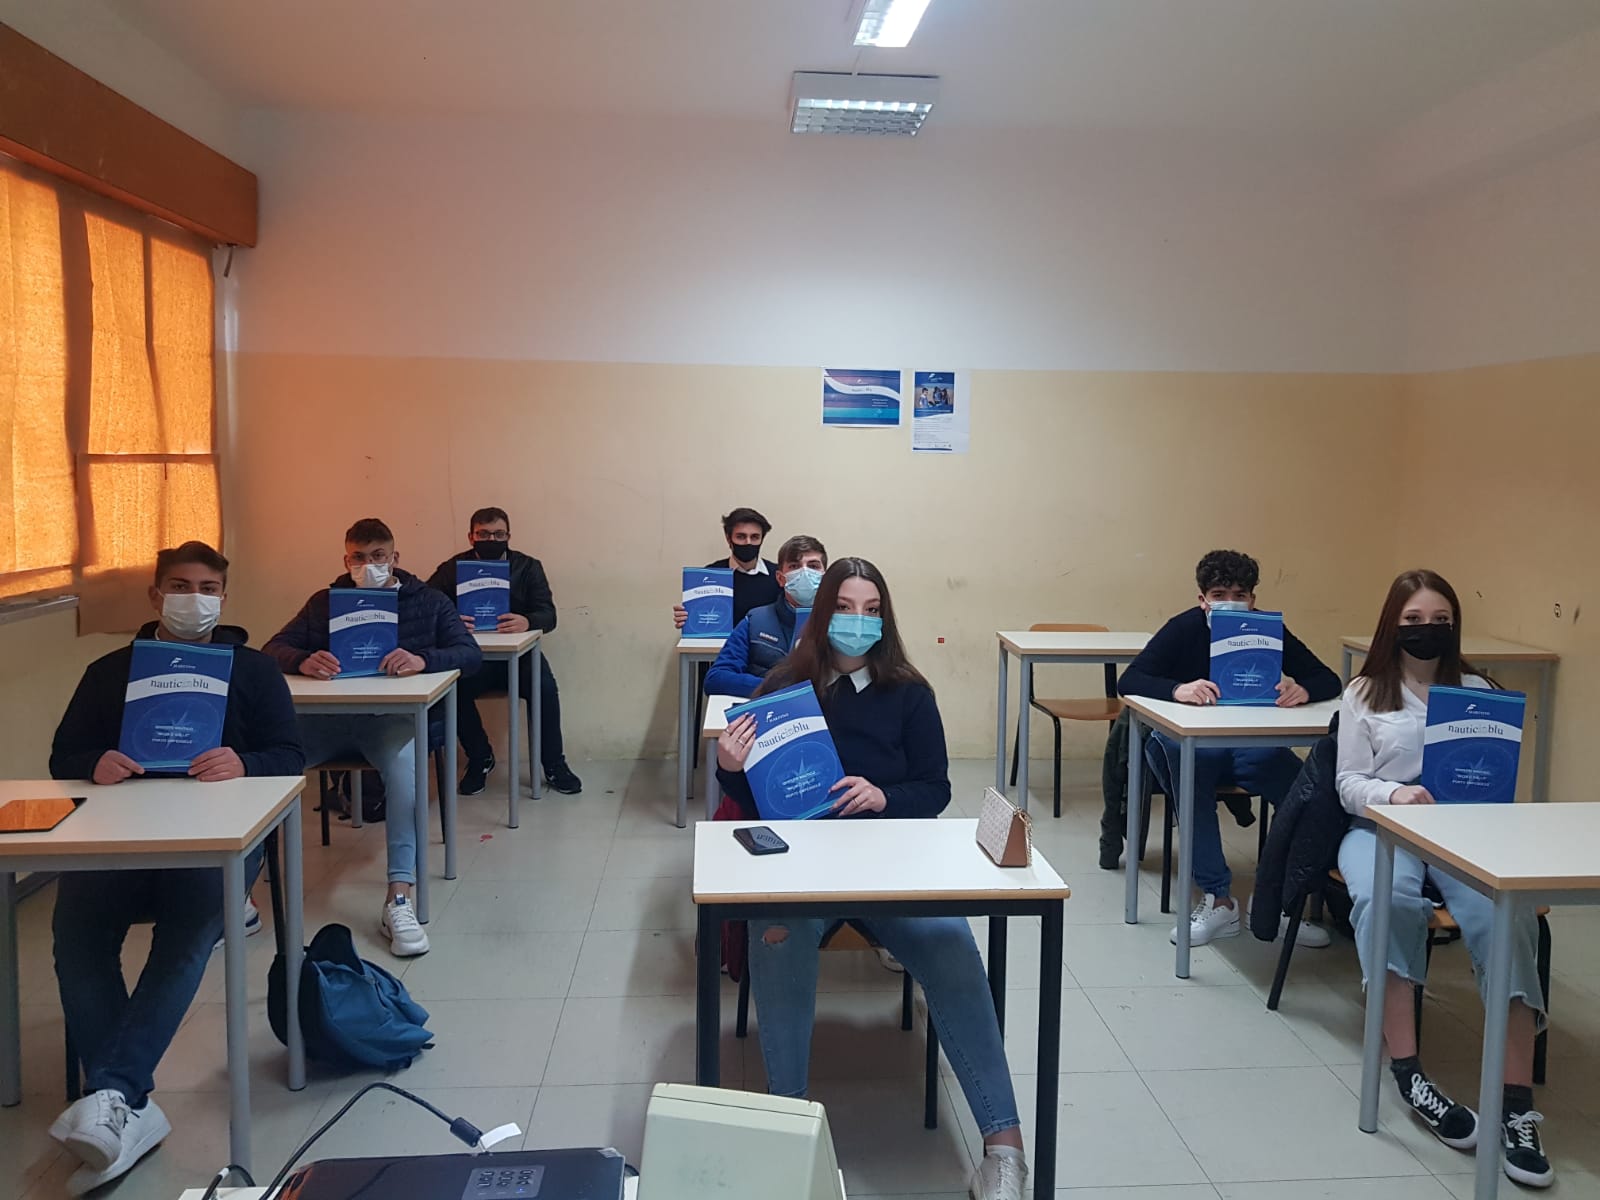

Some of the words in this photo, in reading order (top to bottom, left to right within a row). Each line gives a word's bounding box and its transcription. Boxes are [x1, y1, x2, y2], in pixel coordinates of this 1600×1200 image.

[1227, 638, 1270, 647] nauticblu
[150, 678, 209, 690] nauticblu
[1448, 724, 1504, 735] nauticblu
